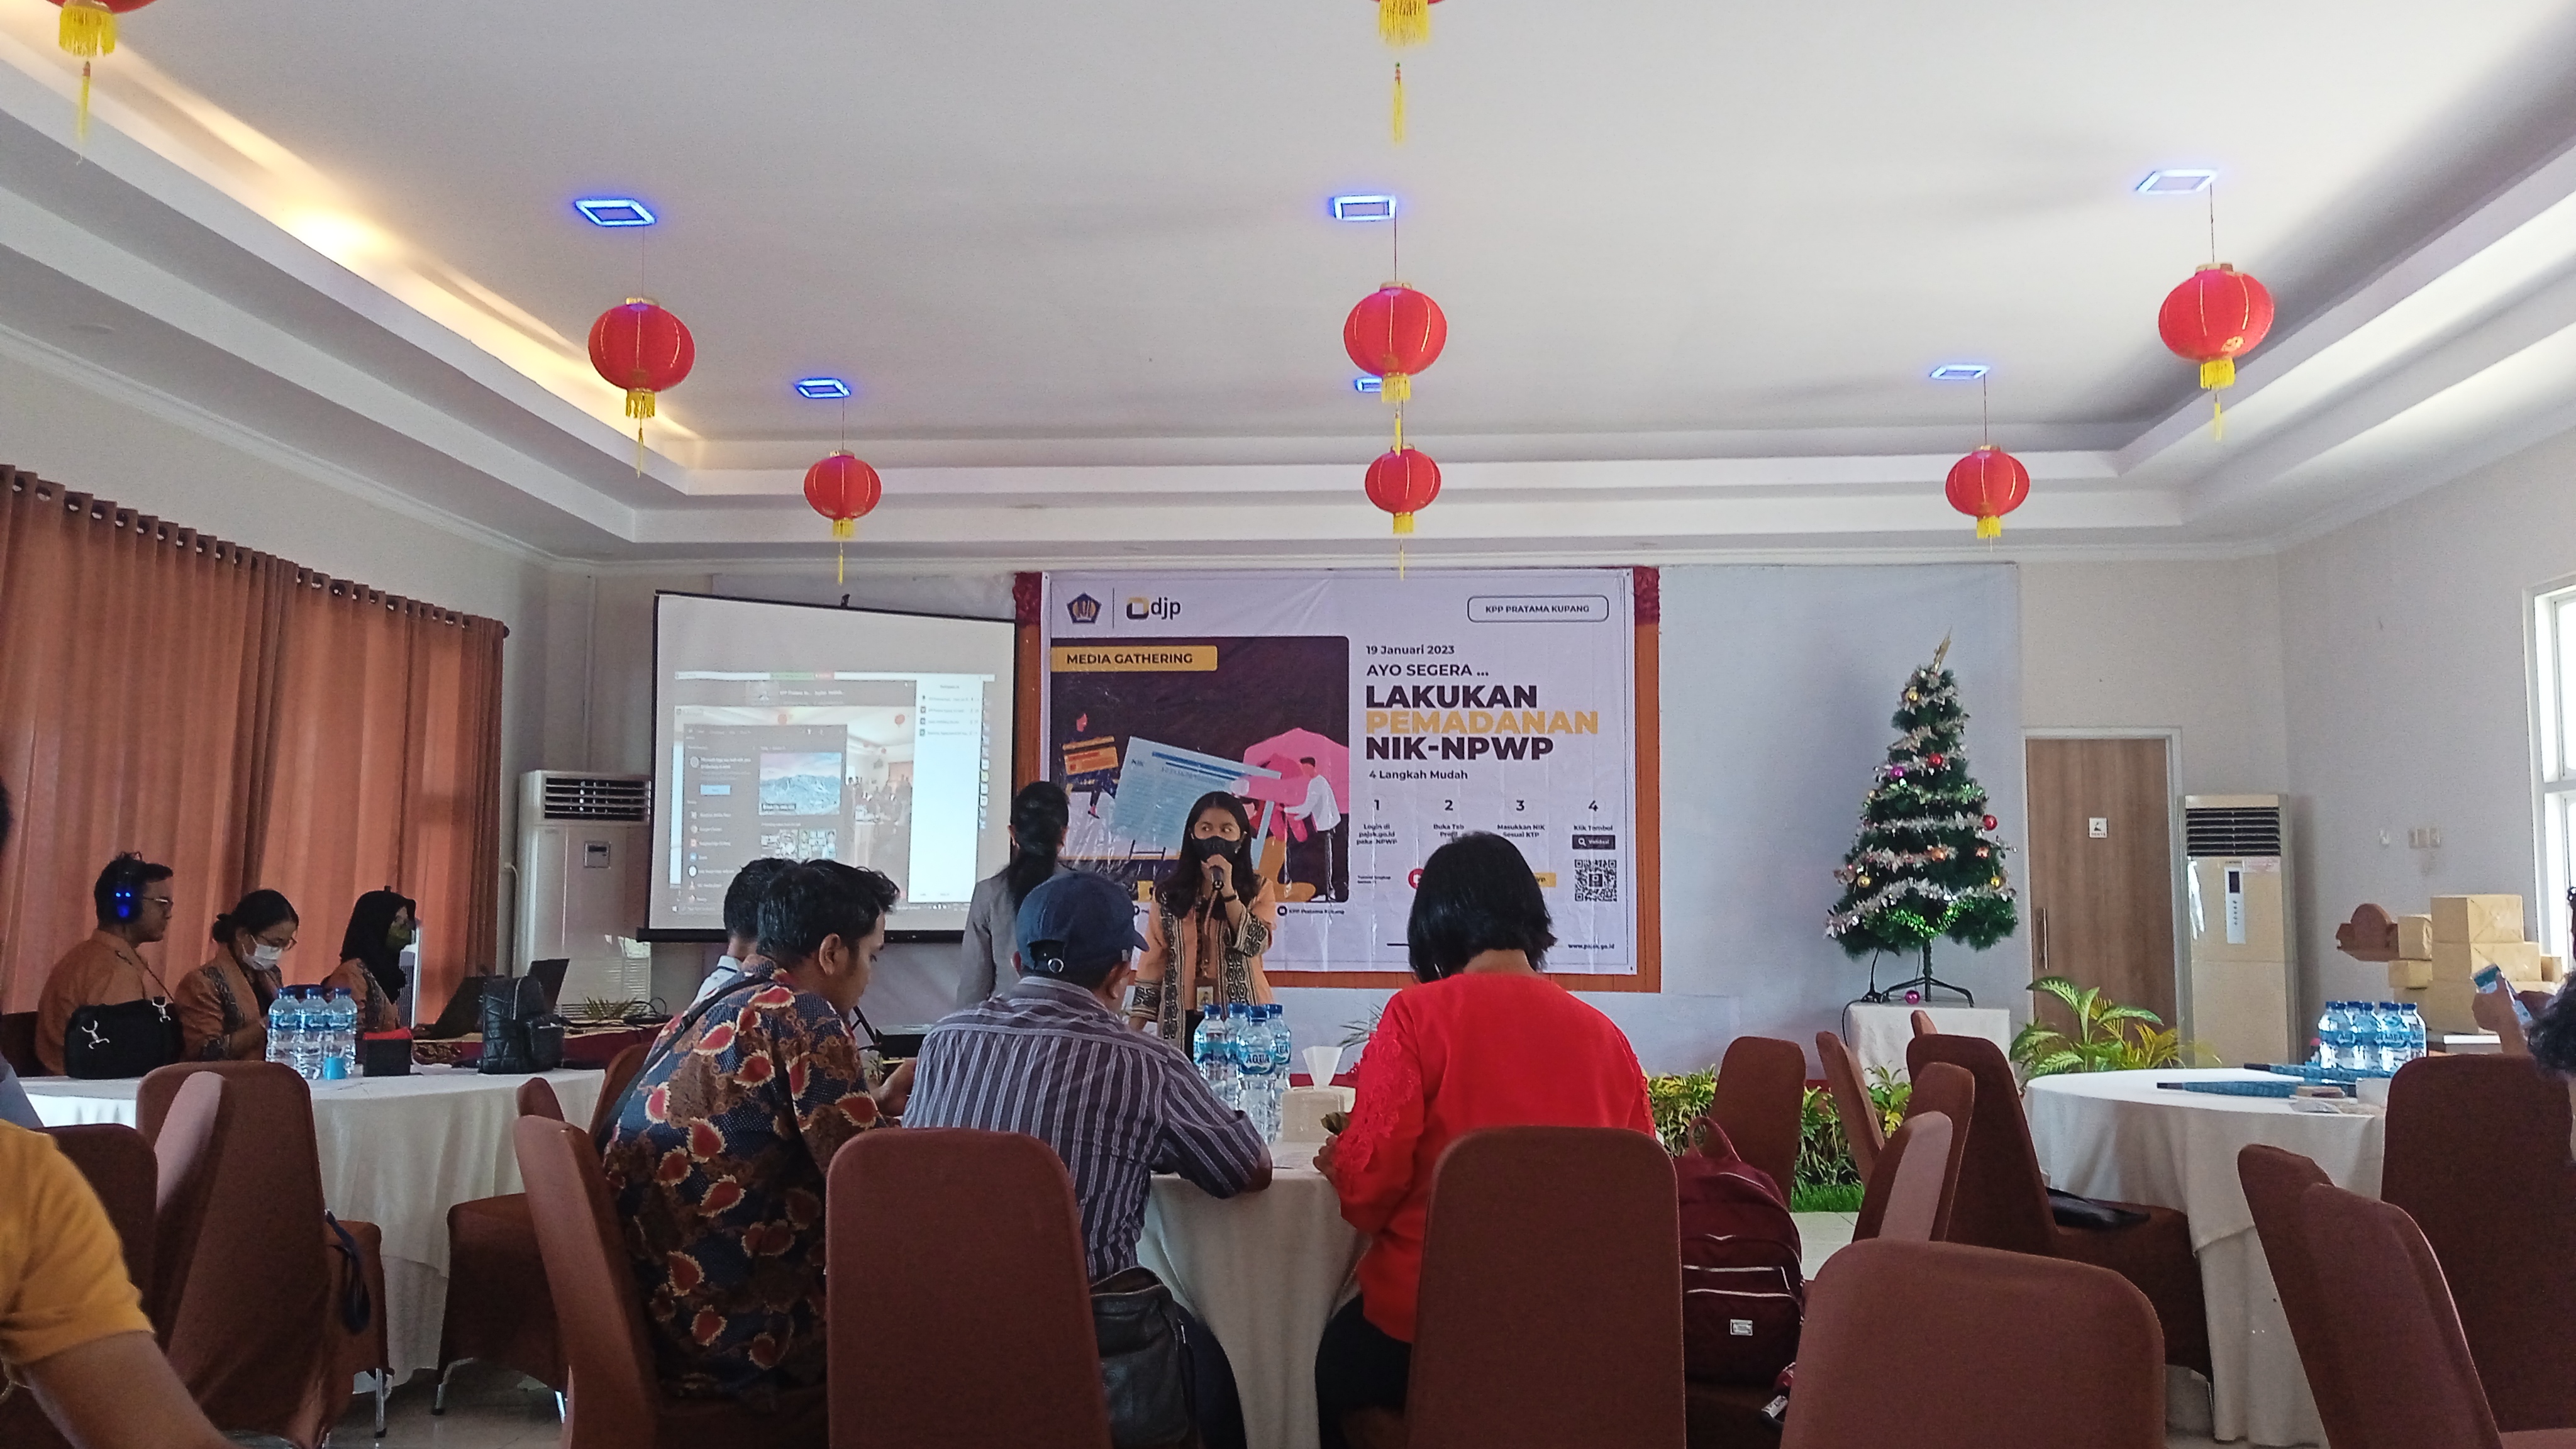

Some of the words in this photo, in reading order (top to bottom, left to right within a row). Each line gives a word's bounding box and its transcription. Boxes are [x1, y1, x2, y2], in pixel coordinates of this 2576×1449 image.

[1151, 597, 1180, 620] djp
[1485, 605, 1504, 613] KPP
[1506, 605, 1550, 613] PRATAMA
[1552, 605, 1590, 613] KUPANG
[1366, 645, 1378, 655] 19
[1380, 644, 1424, 655] Januari
[1427, 645, 1455, 655] 2023
[1067, 653, 1112, 664] MEDIA
[1114, 653, 1193, 664] GATHERING
[1367, 664, 1402, 676] AYO
[1406, 663, 1472, 676] SEGERA
[1366, 685, 1537, 709] LAKUKAN
[1366, 711, 1598, 735] PEMADANAN
[1366, 736, 1554, 760] NIK-NPWP
[1368, 770, 1377, 779] 4
[1379, 770, 1426, 781] Langkah
[1430, 770, 1468, 779] Mudah
[1374, 799, 1380, 811] 1
[1445, 799, 1454, 811] 2
[1516, 800, 1525, 811] 3
[1588, 800, 1599, 812] 4
[1245, 1053, 1270, 1065] AQUA
